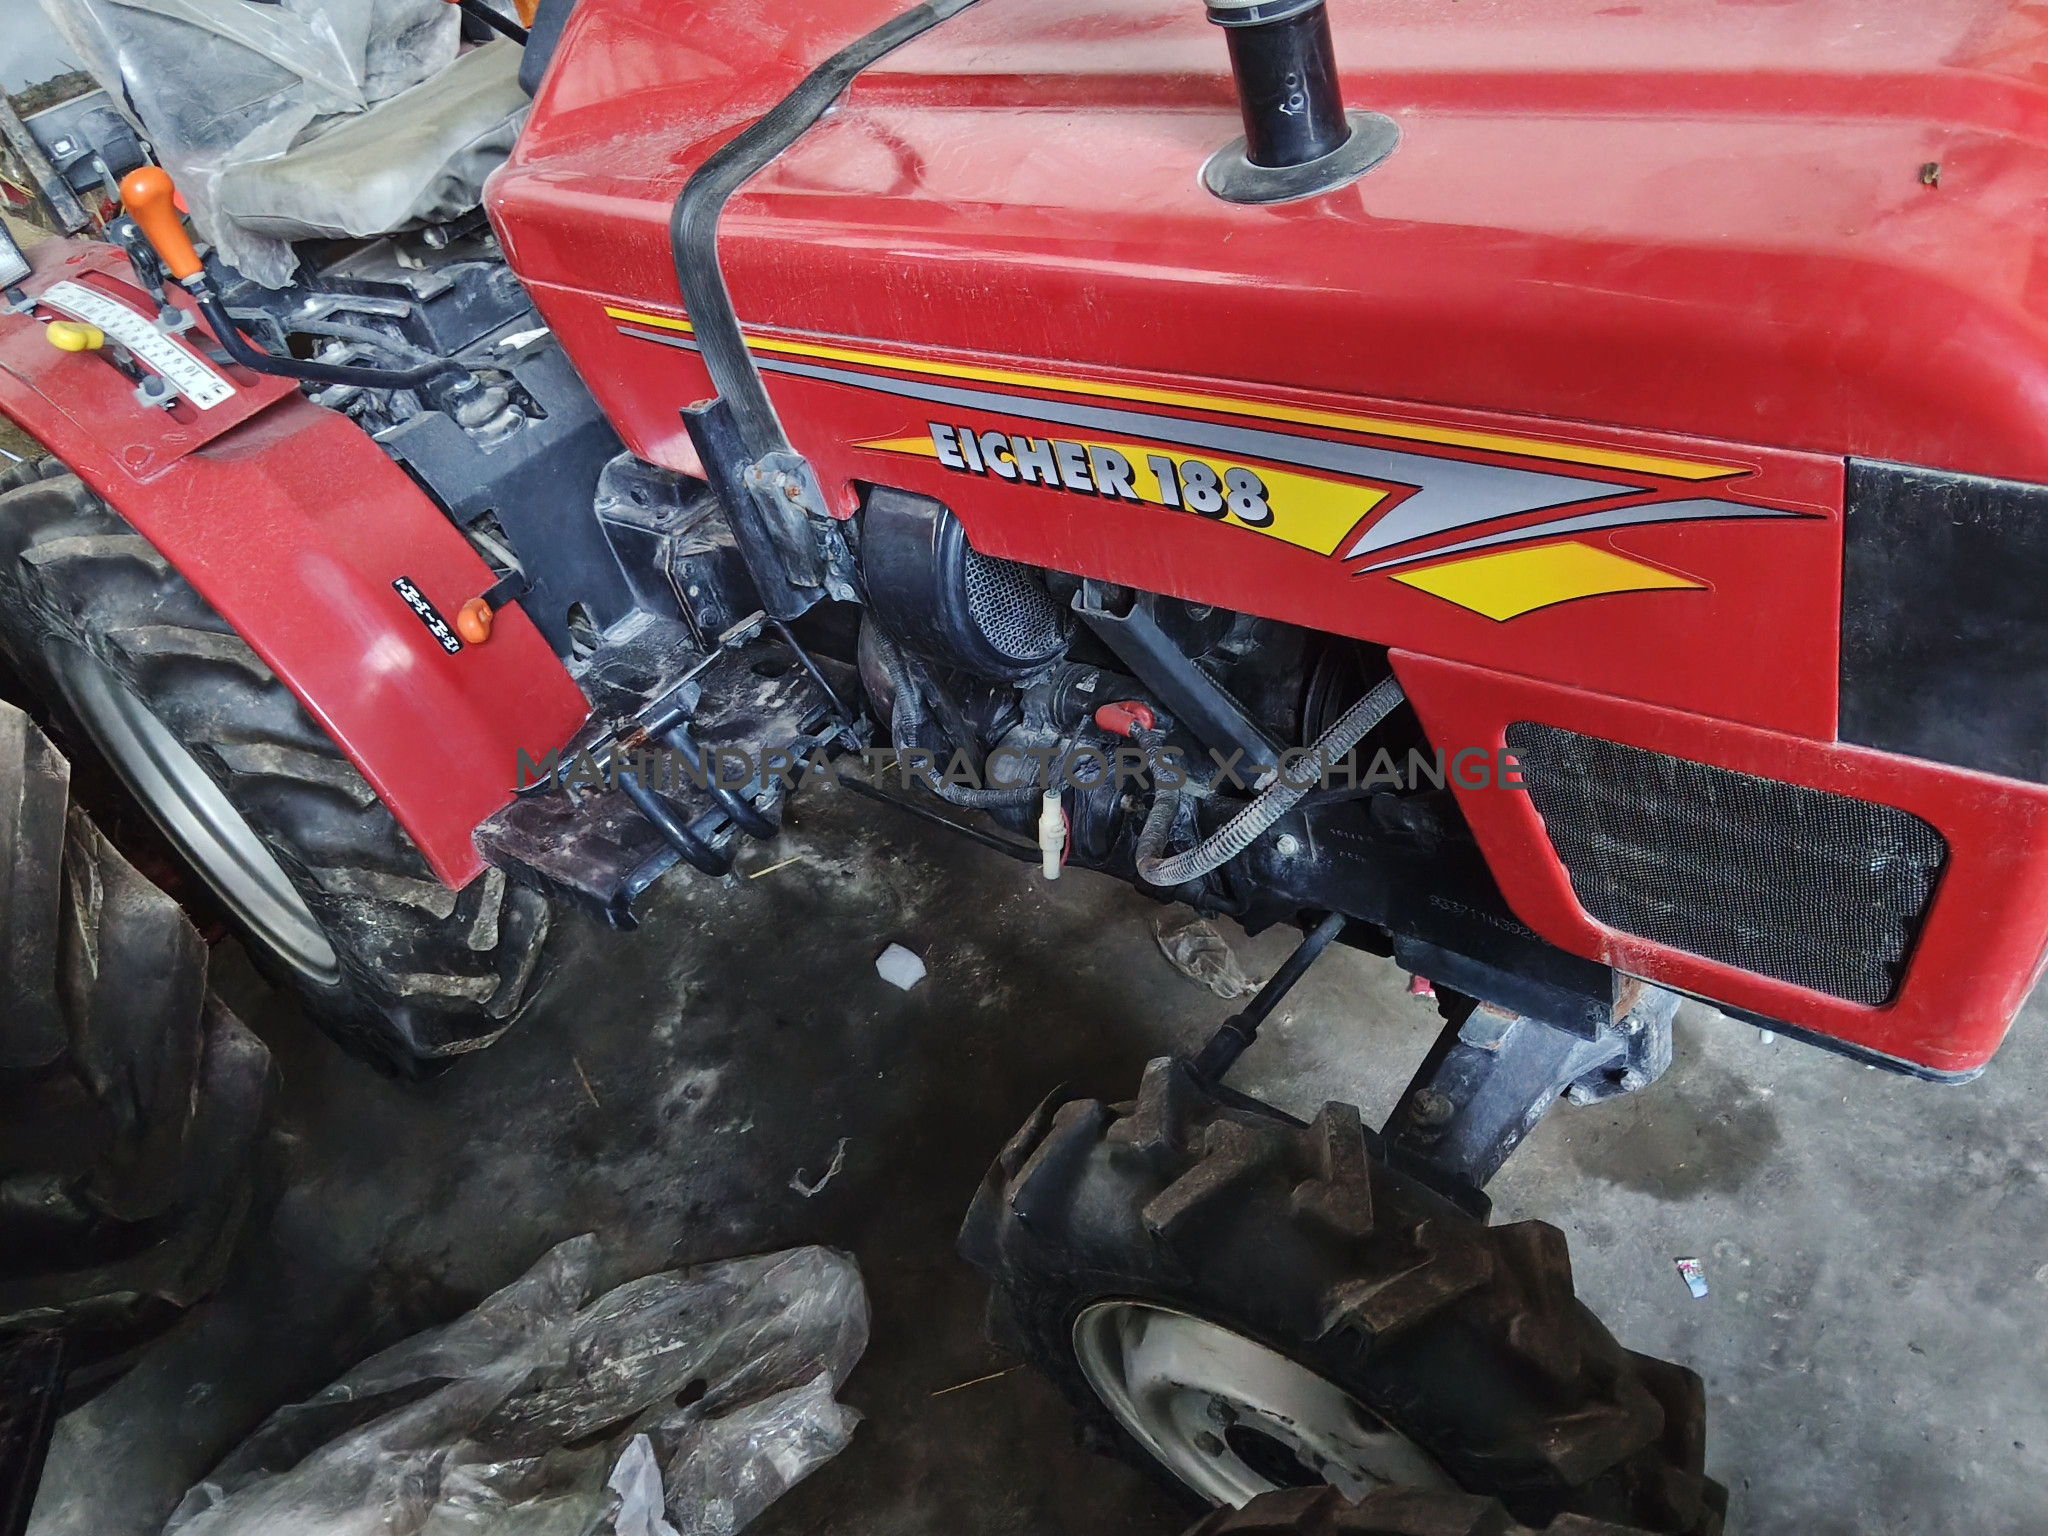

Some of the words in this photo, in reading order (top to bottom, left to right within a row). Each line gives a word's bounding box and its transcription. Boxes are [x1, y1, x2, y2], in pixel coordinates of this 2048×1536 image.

[184, 365, 202, 377] 10
[928, 420, 1143, 505] EICHER
[1147, 454, 1275, 528] 188
